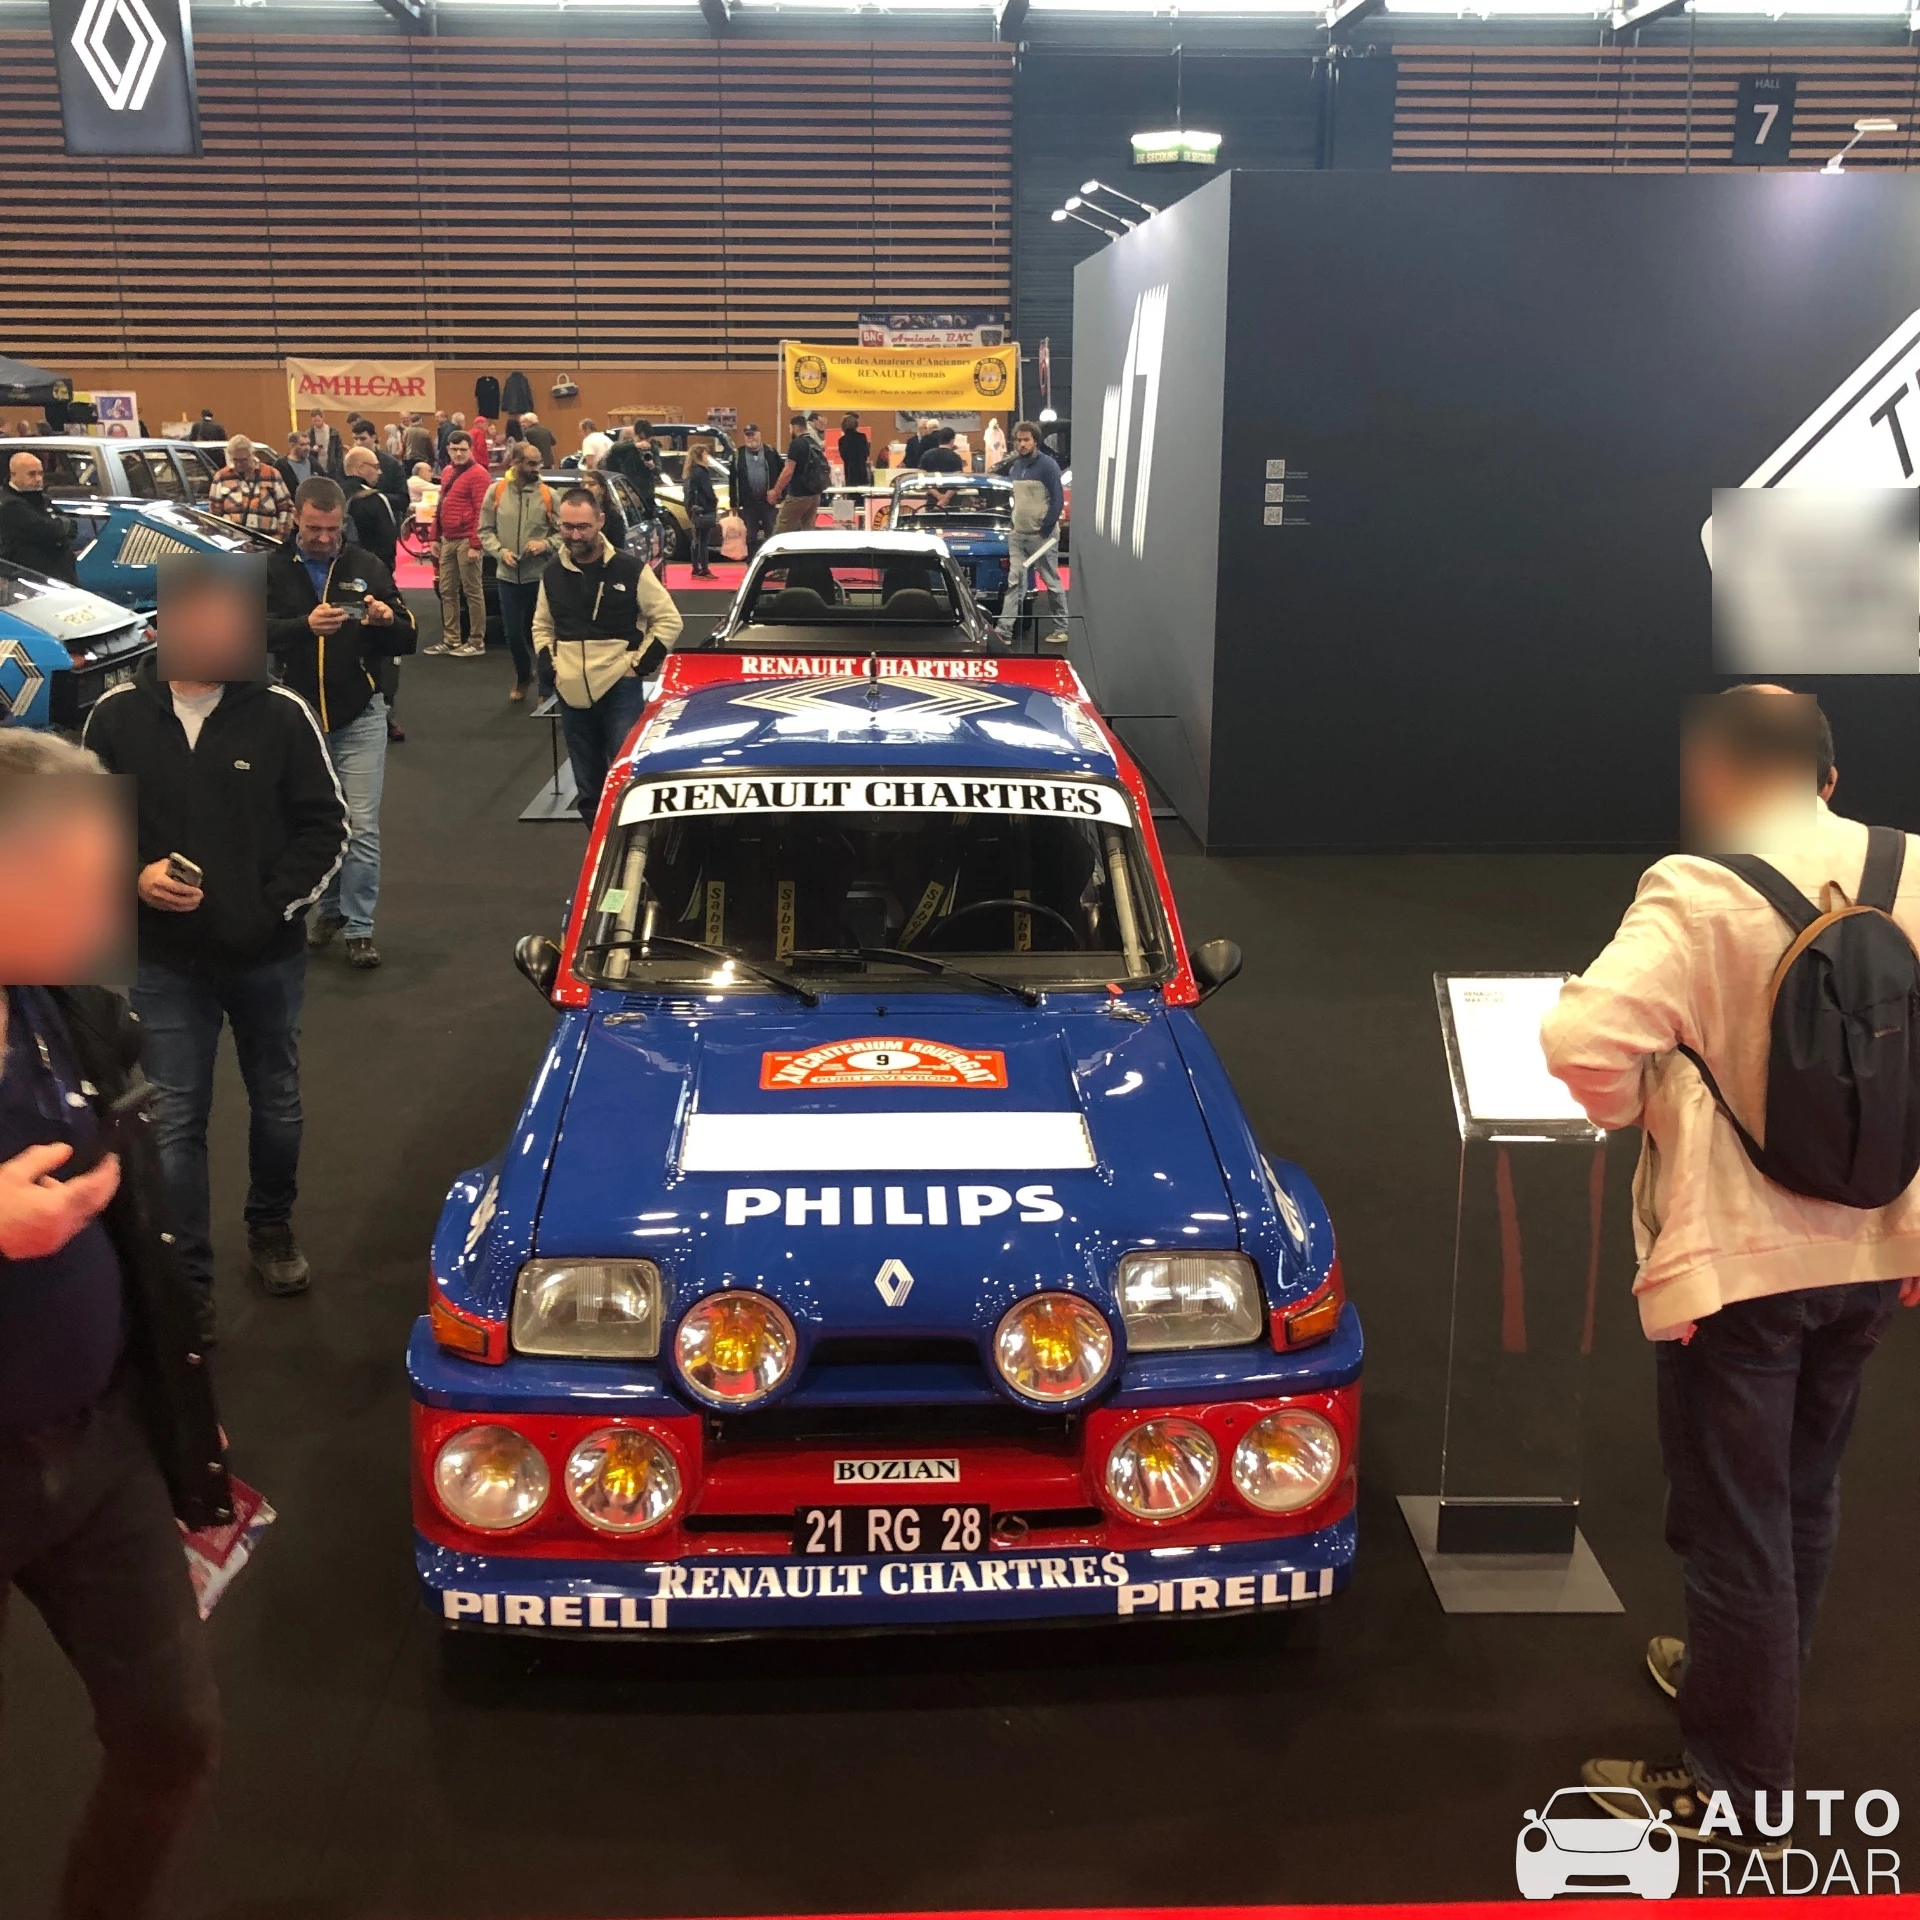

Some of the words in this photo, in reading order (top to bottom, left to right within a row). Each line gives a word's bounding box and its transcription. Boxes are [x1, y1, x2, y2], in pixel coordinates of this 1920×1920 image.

[1755, 79, 1780, 89] HALL
[1753, 104, 1779, 145] 7
[863, 331, 884, 342] BNC
[945, 333, 974, 343] BNC
[830, 356, 852, 365] Club
[854, 356, 869, 365] des
[872, 357, 915, 366] Amateurs
[858, 369, 906, 378] RENAULT
[909, 370, 946, 380] lyonnais
[298, 374, 426, 397] AMILCAR
[741, 656, 857, 677] RENAULT
[862, 656, 998, 678] CHARTRES
[649, 781, 851, 815] RENAULT
[865, 782, 1102, 815] CHARTRES
[709, 887, 721, 945] Sabel
[793, 1041, 904, 1069] CRITERIUM
[909, 1042, 997, 1082] ROUERGAT
[876, 1054, 889, 1066] 9
[725, 1185, 1064, 1226] PHILIPS
[836, 1460, 956, 1481] BOZIAN
[805, 1509, 842, 1553] 21
[867, 1508, 921, 1552] RG
[940, 1507, 982, 1551] 28
[656, 1564, 868, 1600] RENAULT
[879, 1552, 1129, 1595] CHARTRES
[1118, 1568, 1334, 1615] PIRELLI
[443, 1590, 668, 1629] PIRELLI
